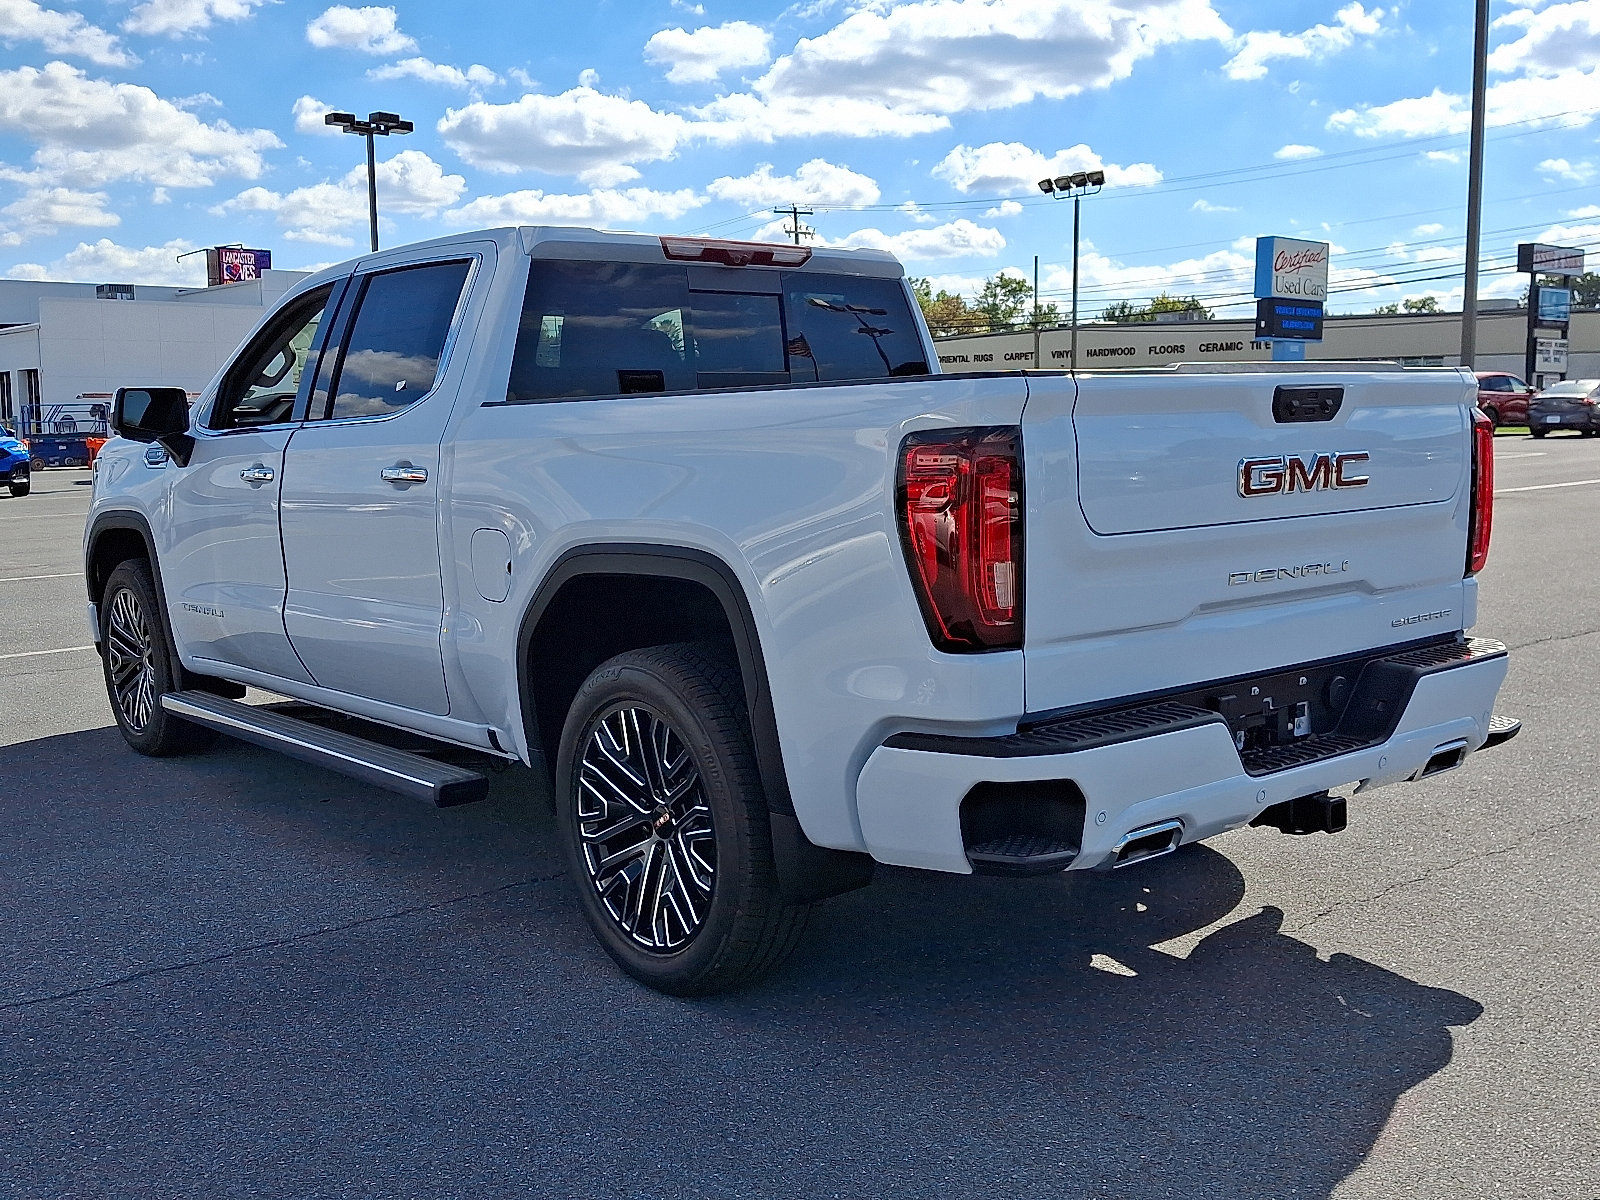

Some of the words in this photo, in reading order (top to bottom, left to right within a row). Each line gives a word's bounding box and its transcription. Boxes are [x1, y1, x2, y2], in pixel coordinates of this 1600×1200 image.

[222, 251, 255, 264] LANCASTER
[1274, 247, 1327, 274] Certified
[1275, 276, 1301, 295] Used
[1303, 278, 1325, 297] Cars
[973, 353, 993, 362] RUGS
[1003, 351, 1034, 361] CARPET
[1086, 346, 1136, 357] HARDWOOD
[1148, 344, 1185, 355] FLOORS
[1198, 341, 1243, 353] CERAMIC
[1237, 450, 1370, 499] GMC
[1228, 559, 1349, 586] DENALI
[1391, 608, 1452, 628] SIERRA
